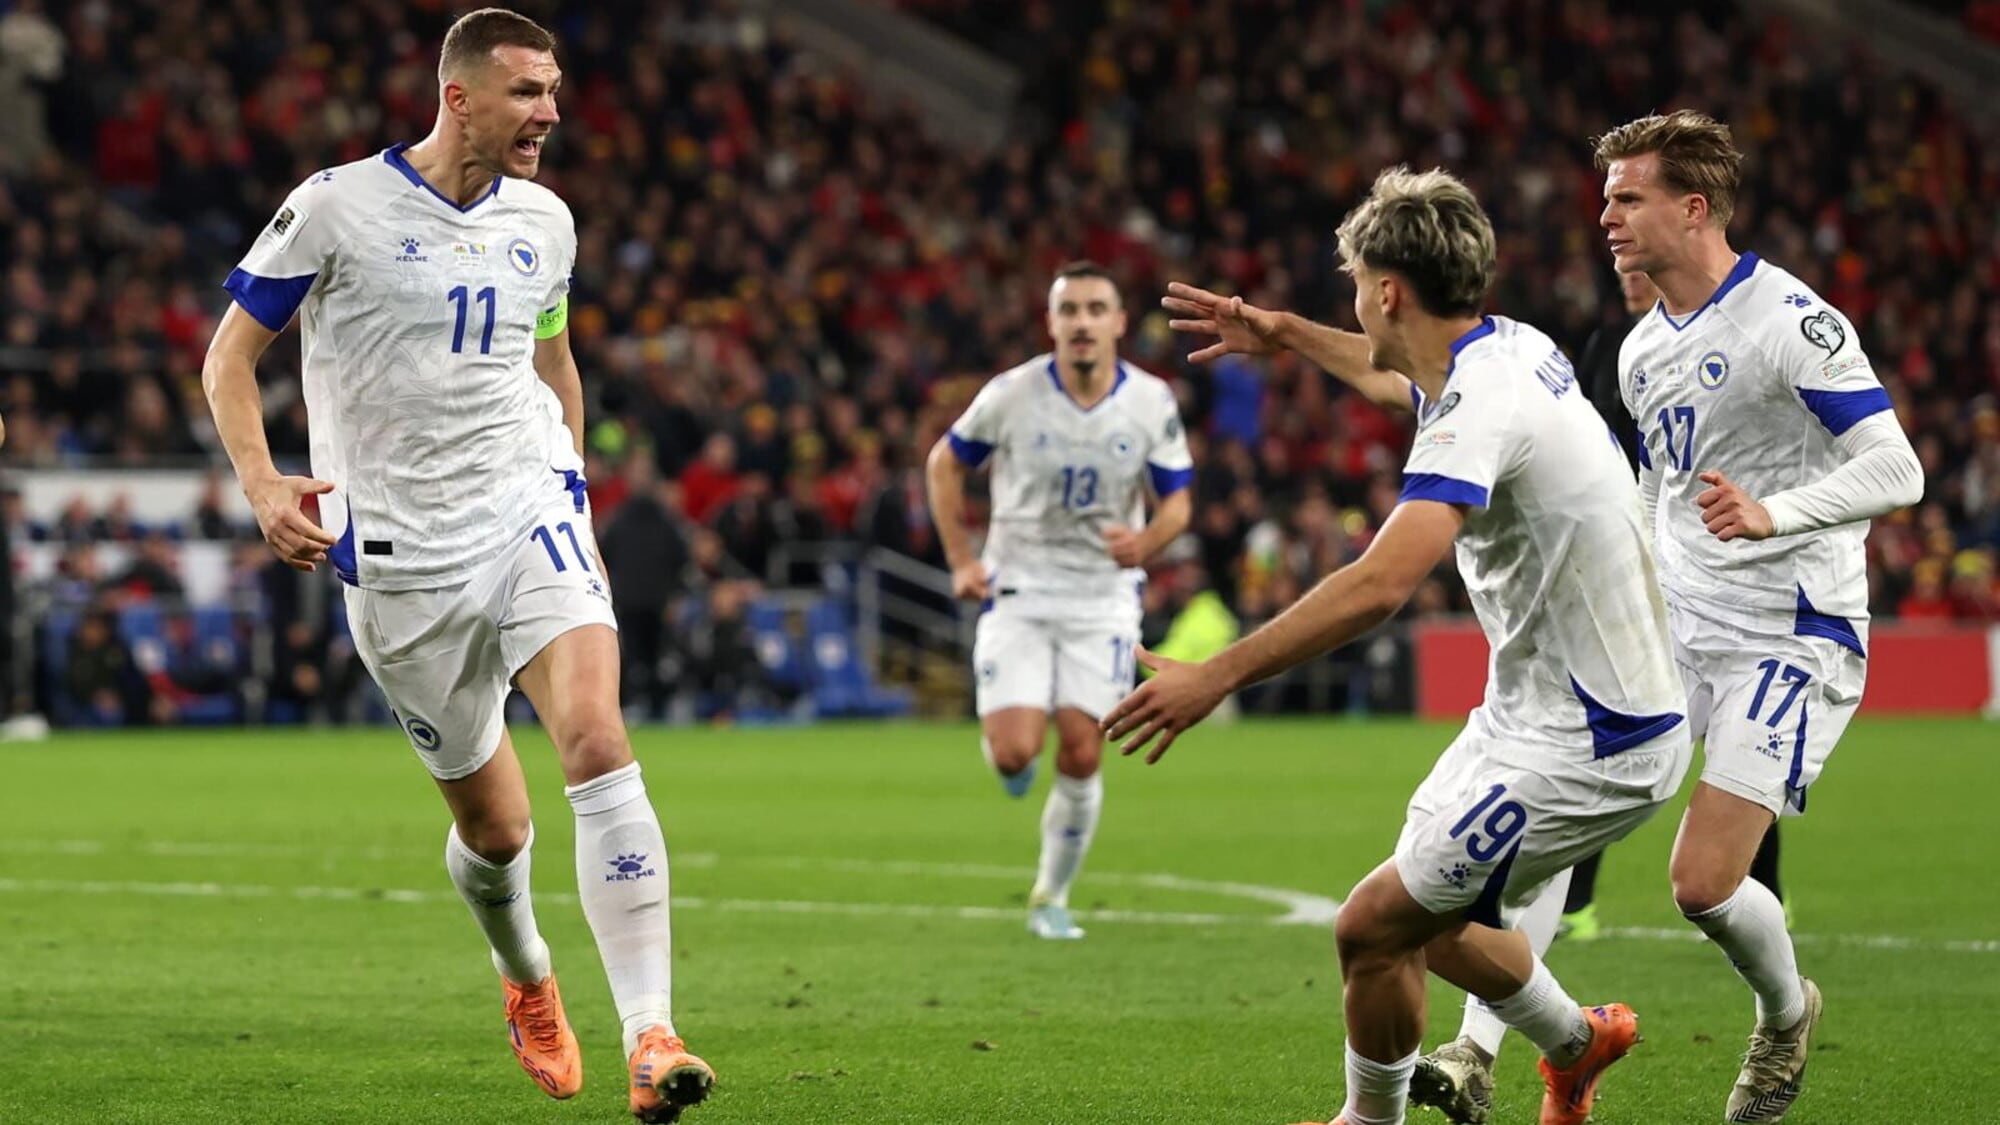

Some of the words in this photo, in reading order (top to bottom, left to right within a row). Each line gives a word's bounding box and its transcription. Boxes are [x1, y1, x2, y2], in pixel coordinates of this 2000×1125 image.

[447, 285, 496, 355] 11
[1657, 406, 1695, 471] 17
[1061, 466, 1098, 508] 13
[530, 521, 591, 573] 11
[1746, 658, 1812, 728] 17
[1755, 745, 1782, 762] KELME
[1448, 783, 1527, 862] 19
[605, 868, 656, 882] KELME
